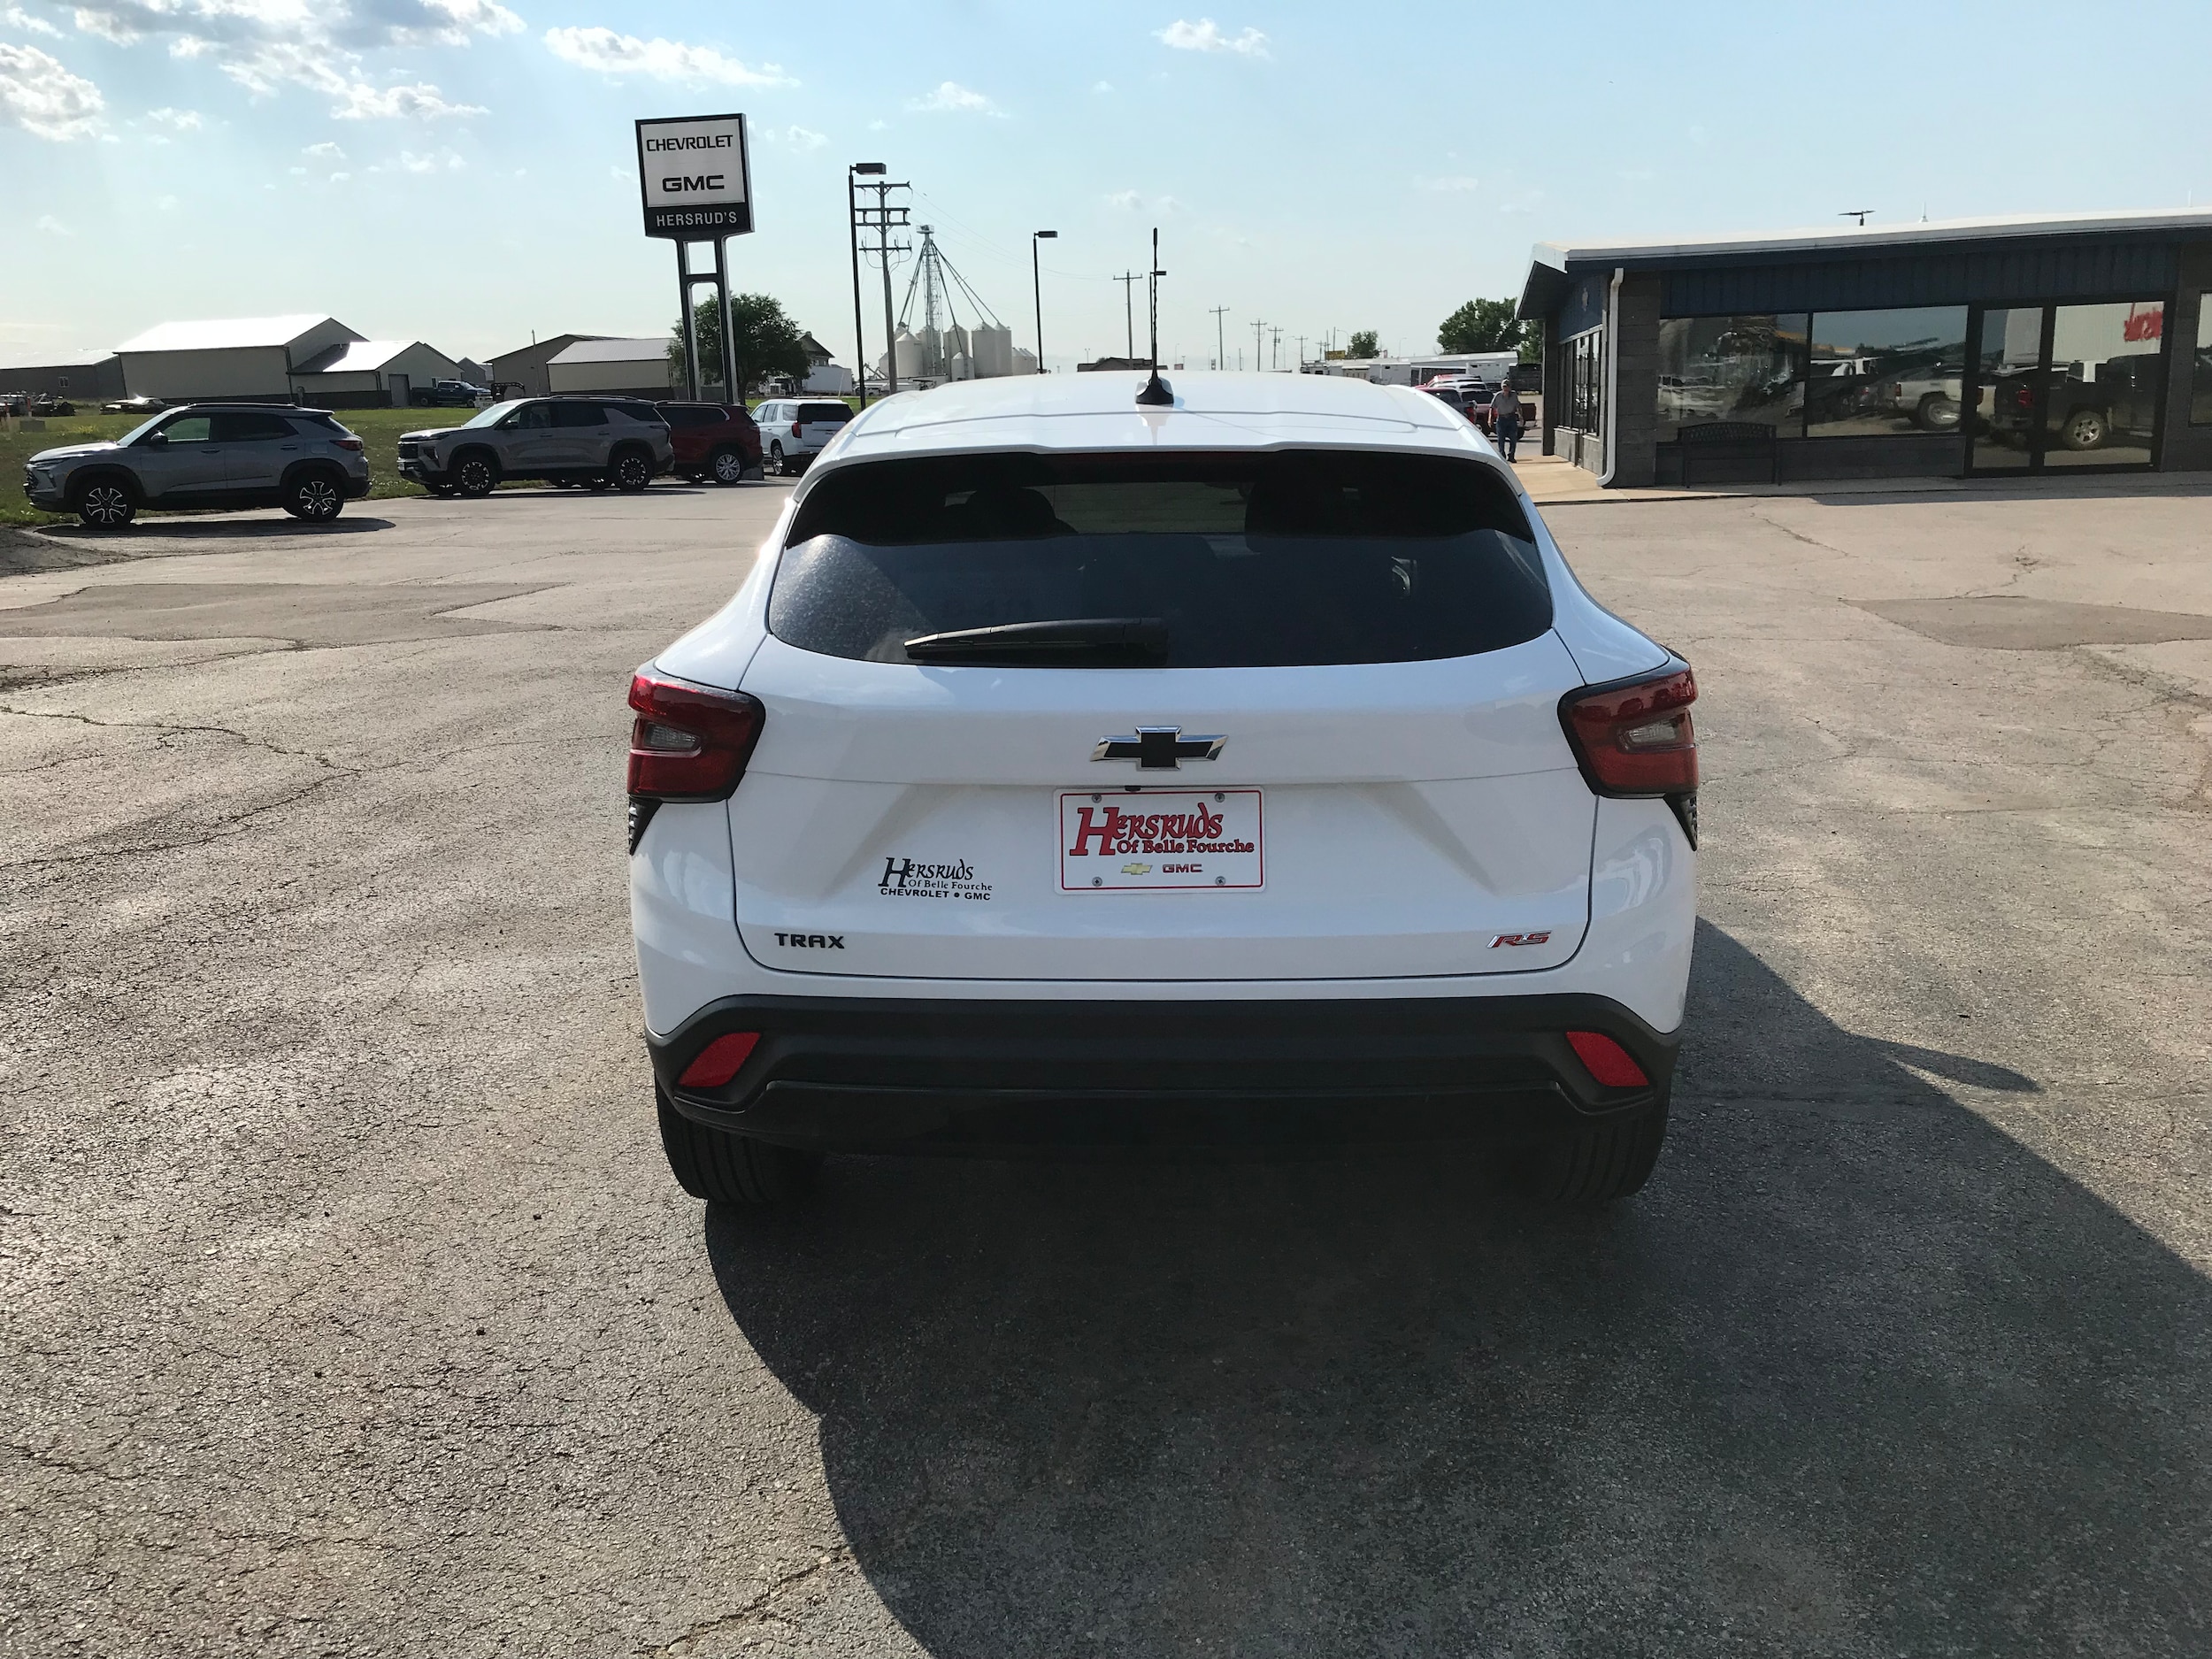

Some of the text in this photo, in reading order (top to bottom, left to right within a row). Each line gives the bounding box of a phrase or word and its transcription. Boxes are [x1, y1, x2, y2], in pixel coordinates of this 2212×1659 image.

[646, 134, 733, 151] CHEVROLET
[662, 174, 725, 192] GMC
[657, 211, 737, 227] HERSRUD'S
[1116, 838, 1255, 854] Of Belle Fourche
[1162, 864, 1203, 873] GMC
[908, 879, 993, 891] Of Belle Fourche
[880, 887, 991, 901] CHEVROLET GMC
[774, 933, 845, 949] TRAX
[1486, 929, 1552, 949] RS
